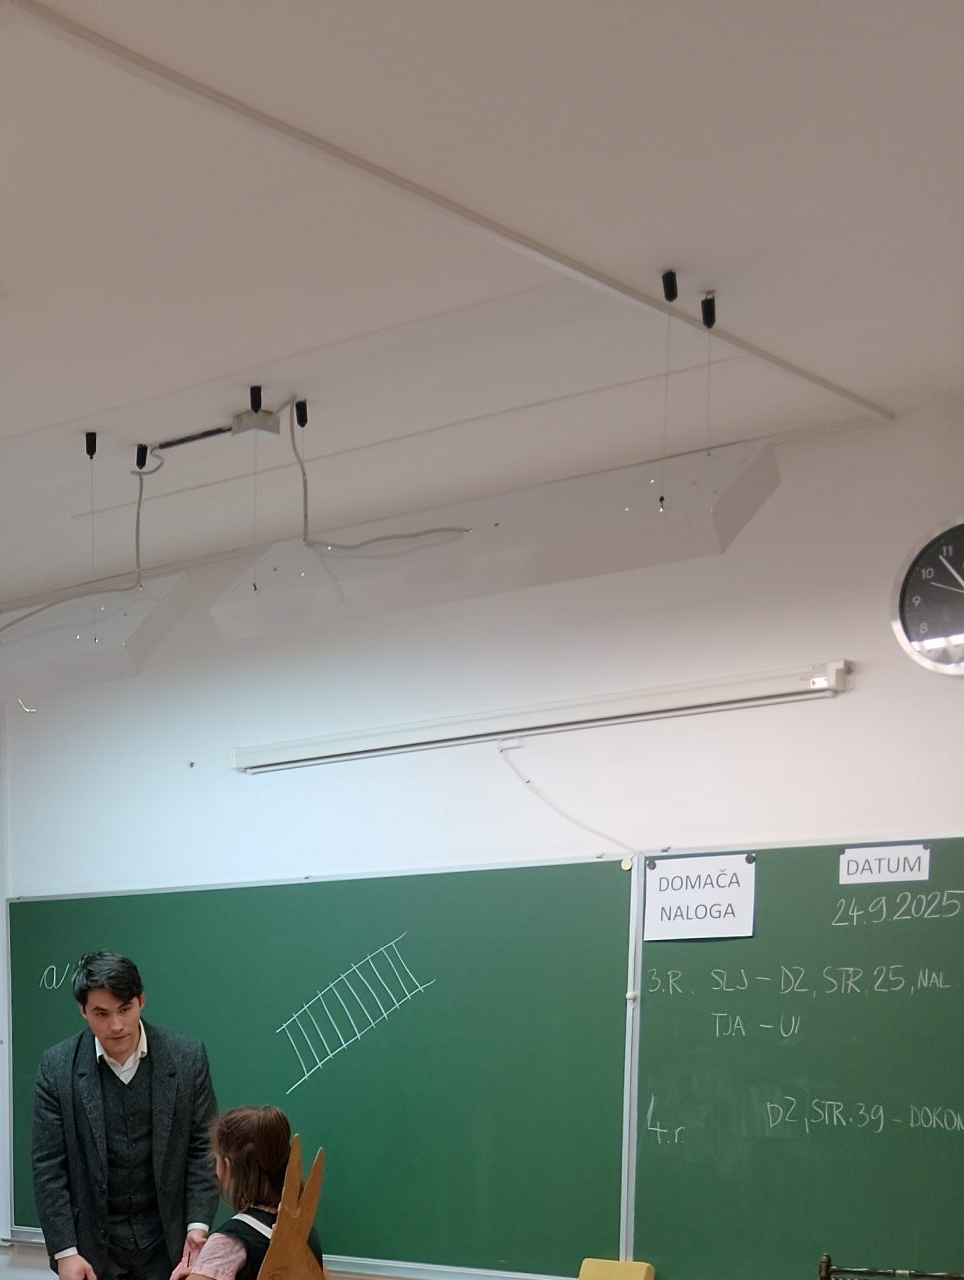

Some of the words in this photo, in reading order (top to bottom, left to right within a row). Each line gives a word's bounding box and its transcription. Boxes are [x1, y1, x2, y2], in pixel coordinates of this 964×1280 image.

[942, 545, 953, 557] 11
[921, 567, 934, 579] 10
[912, 595, 921, 607] 9
[919, 622, 929, 634] 8
[846, 856, 922, 876] DATUM
[658, 868, 741, 892] DOMAČA
[660, 903, 736, 922] NALOGA
